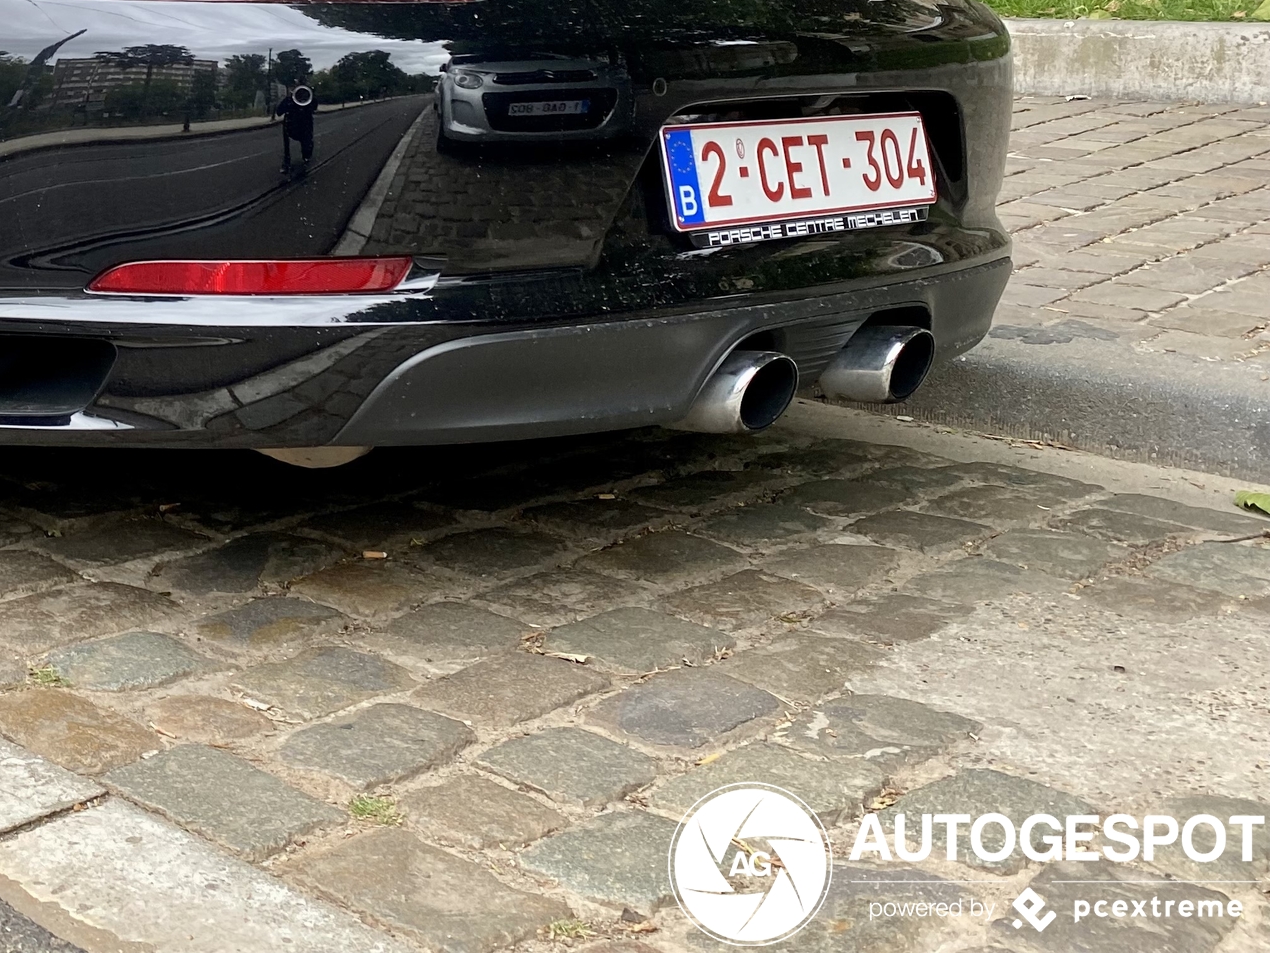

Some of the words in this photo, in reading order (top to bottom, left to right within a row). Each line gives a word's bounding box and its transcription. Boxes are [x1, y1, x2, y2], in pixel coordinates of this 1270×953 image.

[680, 185, 699, 217] B
[709, 226, 783, 246] PORSCHE
[785, 219, 845, 238] CENTRE
[847, 209, 919, 229] MECHELEN
